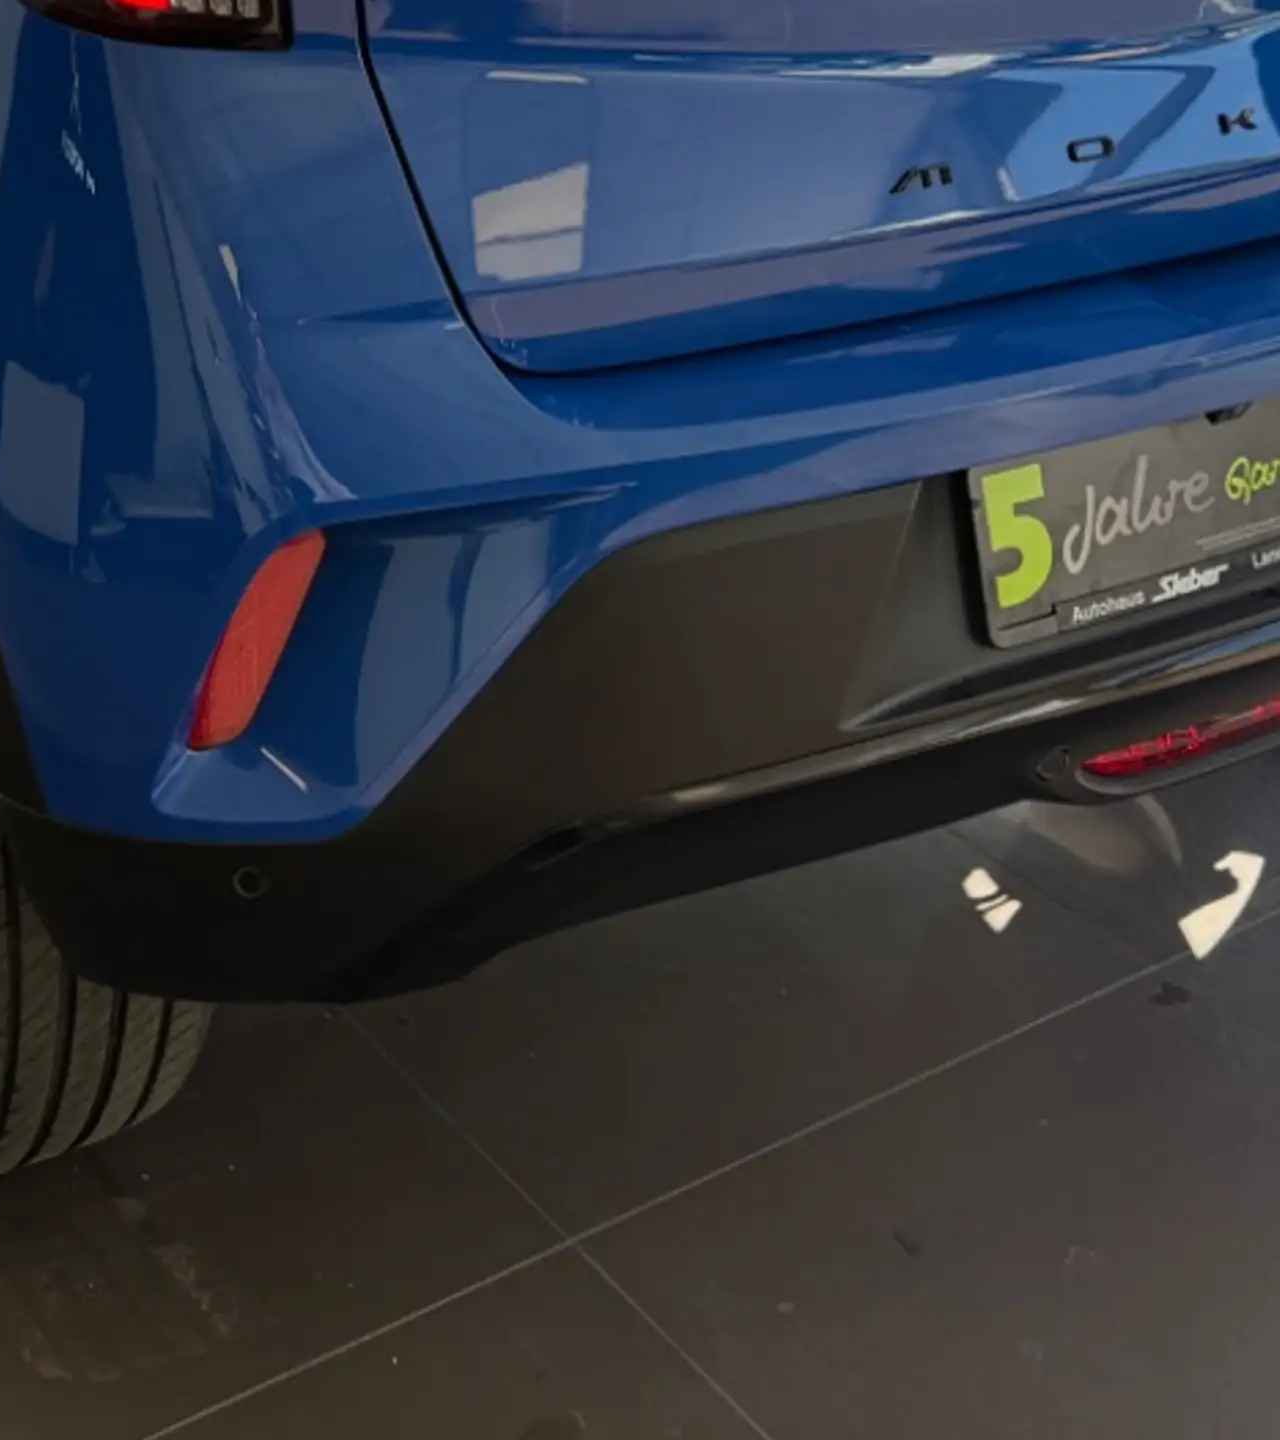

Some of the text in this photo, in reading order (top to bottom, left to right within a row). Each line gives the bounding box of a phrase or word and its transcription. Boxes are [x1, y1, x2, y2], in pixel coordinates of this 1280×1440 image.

[981, 463, 1053, 608] 5
[1063, 454, 1217, 574] Jahre
[1073, 591, 1146, 624] Autohaus
[1151, 563, 1230, 603] Sieber
